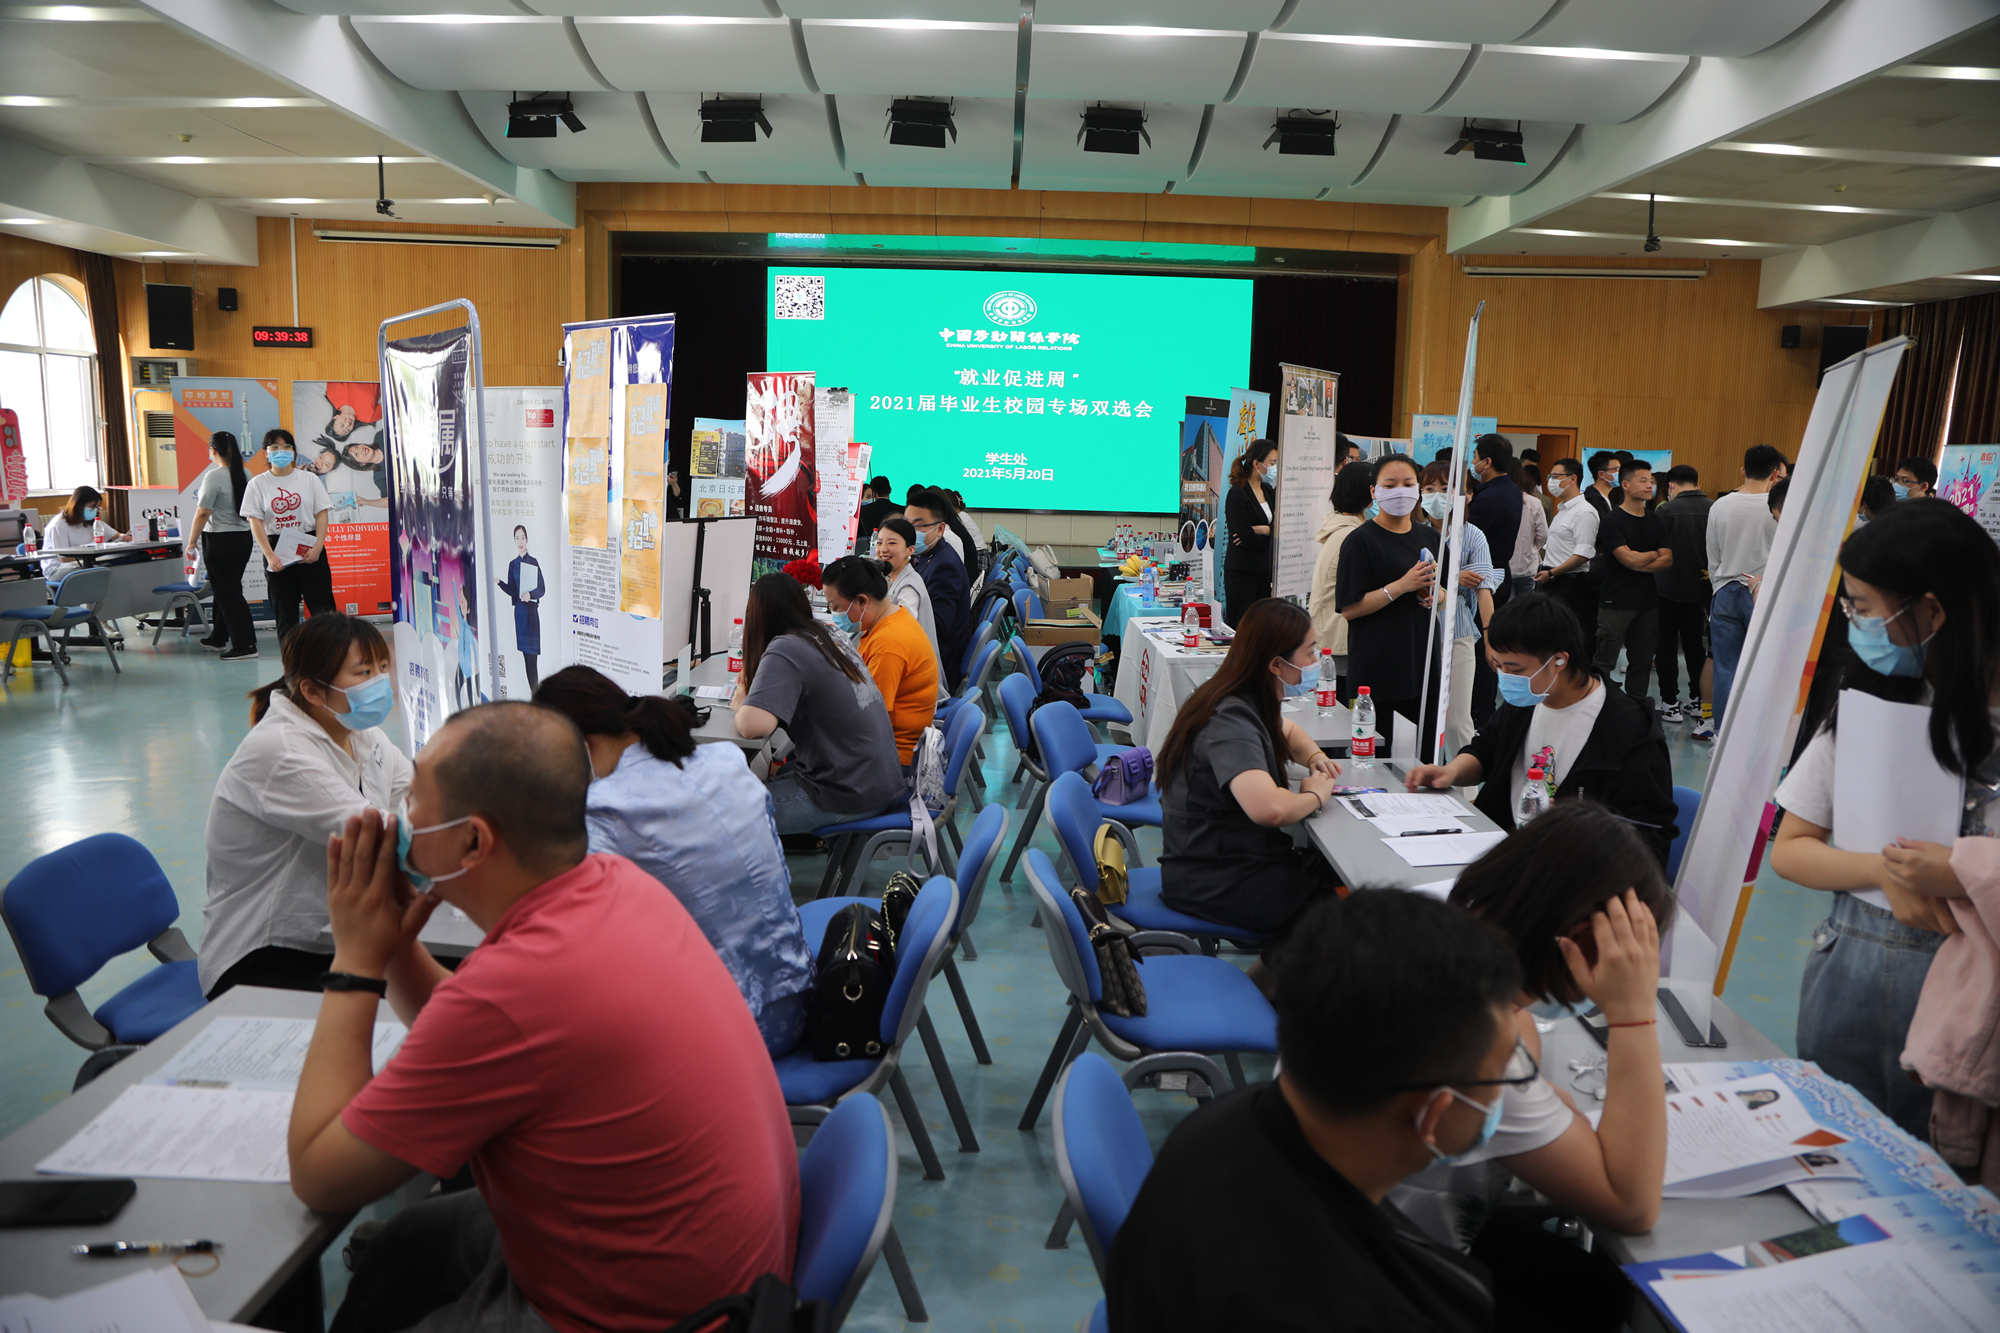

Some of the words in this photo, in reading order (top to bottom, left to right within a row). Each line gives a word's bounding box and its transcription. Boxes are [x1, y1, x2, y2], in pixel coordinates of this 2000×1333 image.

[254, 330, 308, 342] 09:39:38
[184, 391, 230, 399] 你的梦想
[870, 394, 1154, 418] 2021届毕业生校园专场双选会
[495, 439, 511, 447] have
[520, 440, 536, 450] great
[538, 440, 555, 448] start
[487, 453, 532, 465] 成功的开始
[985, 452, 1028, 466] 学生处
[962, 467, 1054, 481] 2021年5月20日
[699, 485, 745, 494] 北京日坛宾
[1949, 484, 1974, 506] 2021
[142, 506, 180, 519] east
[276, 521, 301, 529] Cherry
